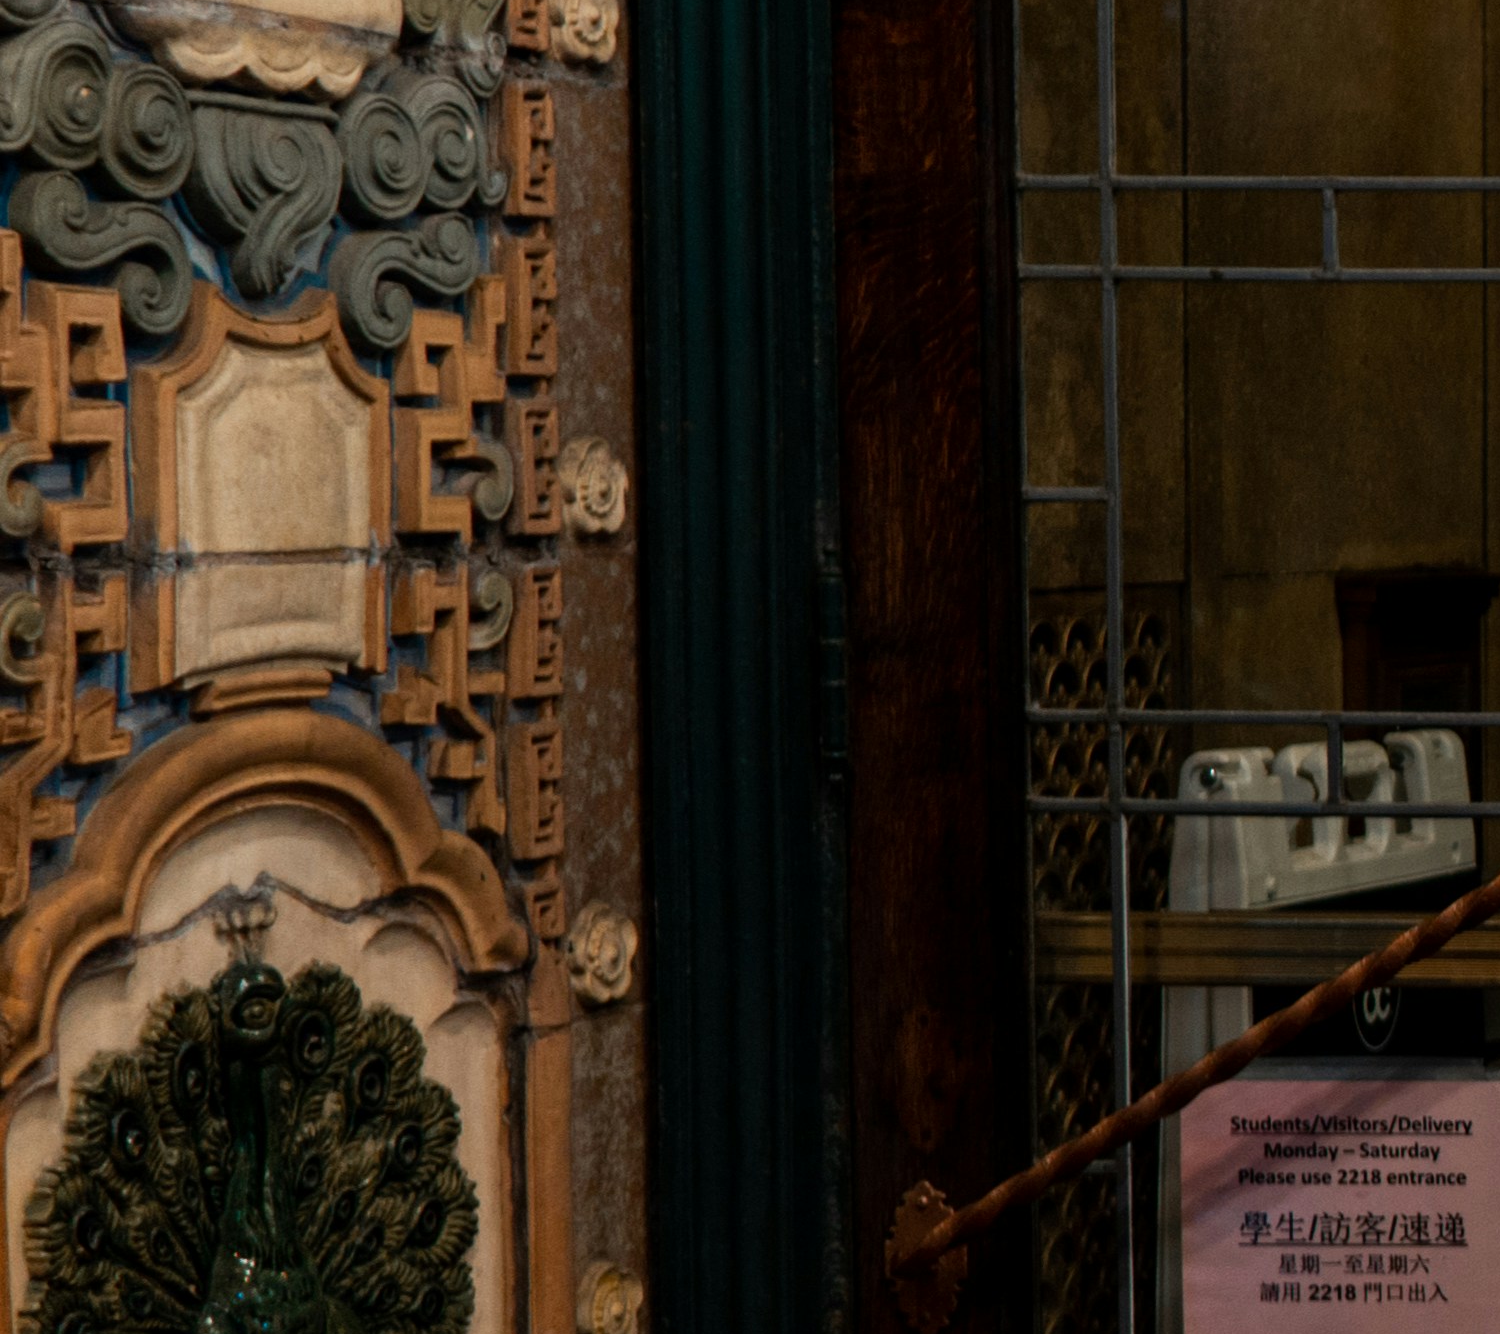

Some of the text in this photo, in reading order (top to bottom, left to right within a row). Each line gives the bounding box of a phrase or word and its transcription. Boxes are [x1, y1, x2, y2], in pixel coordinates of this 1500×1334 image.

[1230, 1115, 1474, 1134] Students/Visitors/Delivery
[1264, 1141, 1338, 1162] Monday
[1360, 1142, 1440, 1162] Saturday
[1237, 1169, 1467, 1186] Please use 2218 entrance
[1280, 1254, 1429, 1274] 星期一至星期六
[1260, 1282, 1448, 1303] 請用 2218 門口出入
